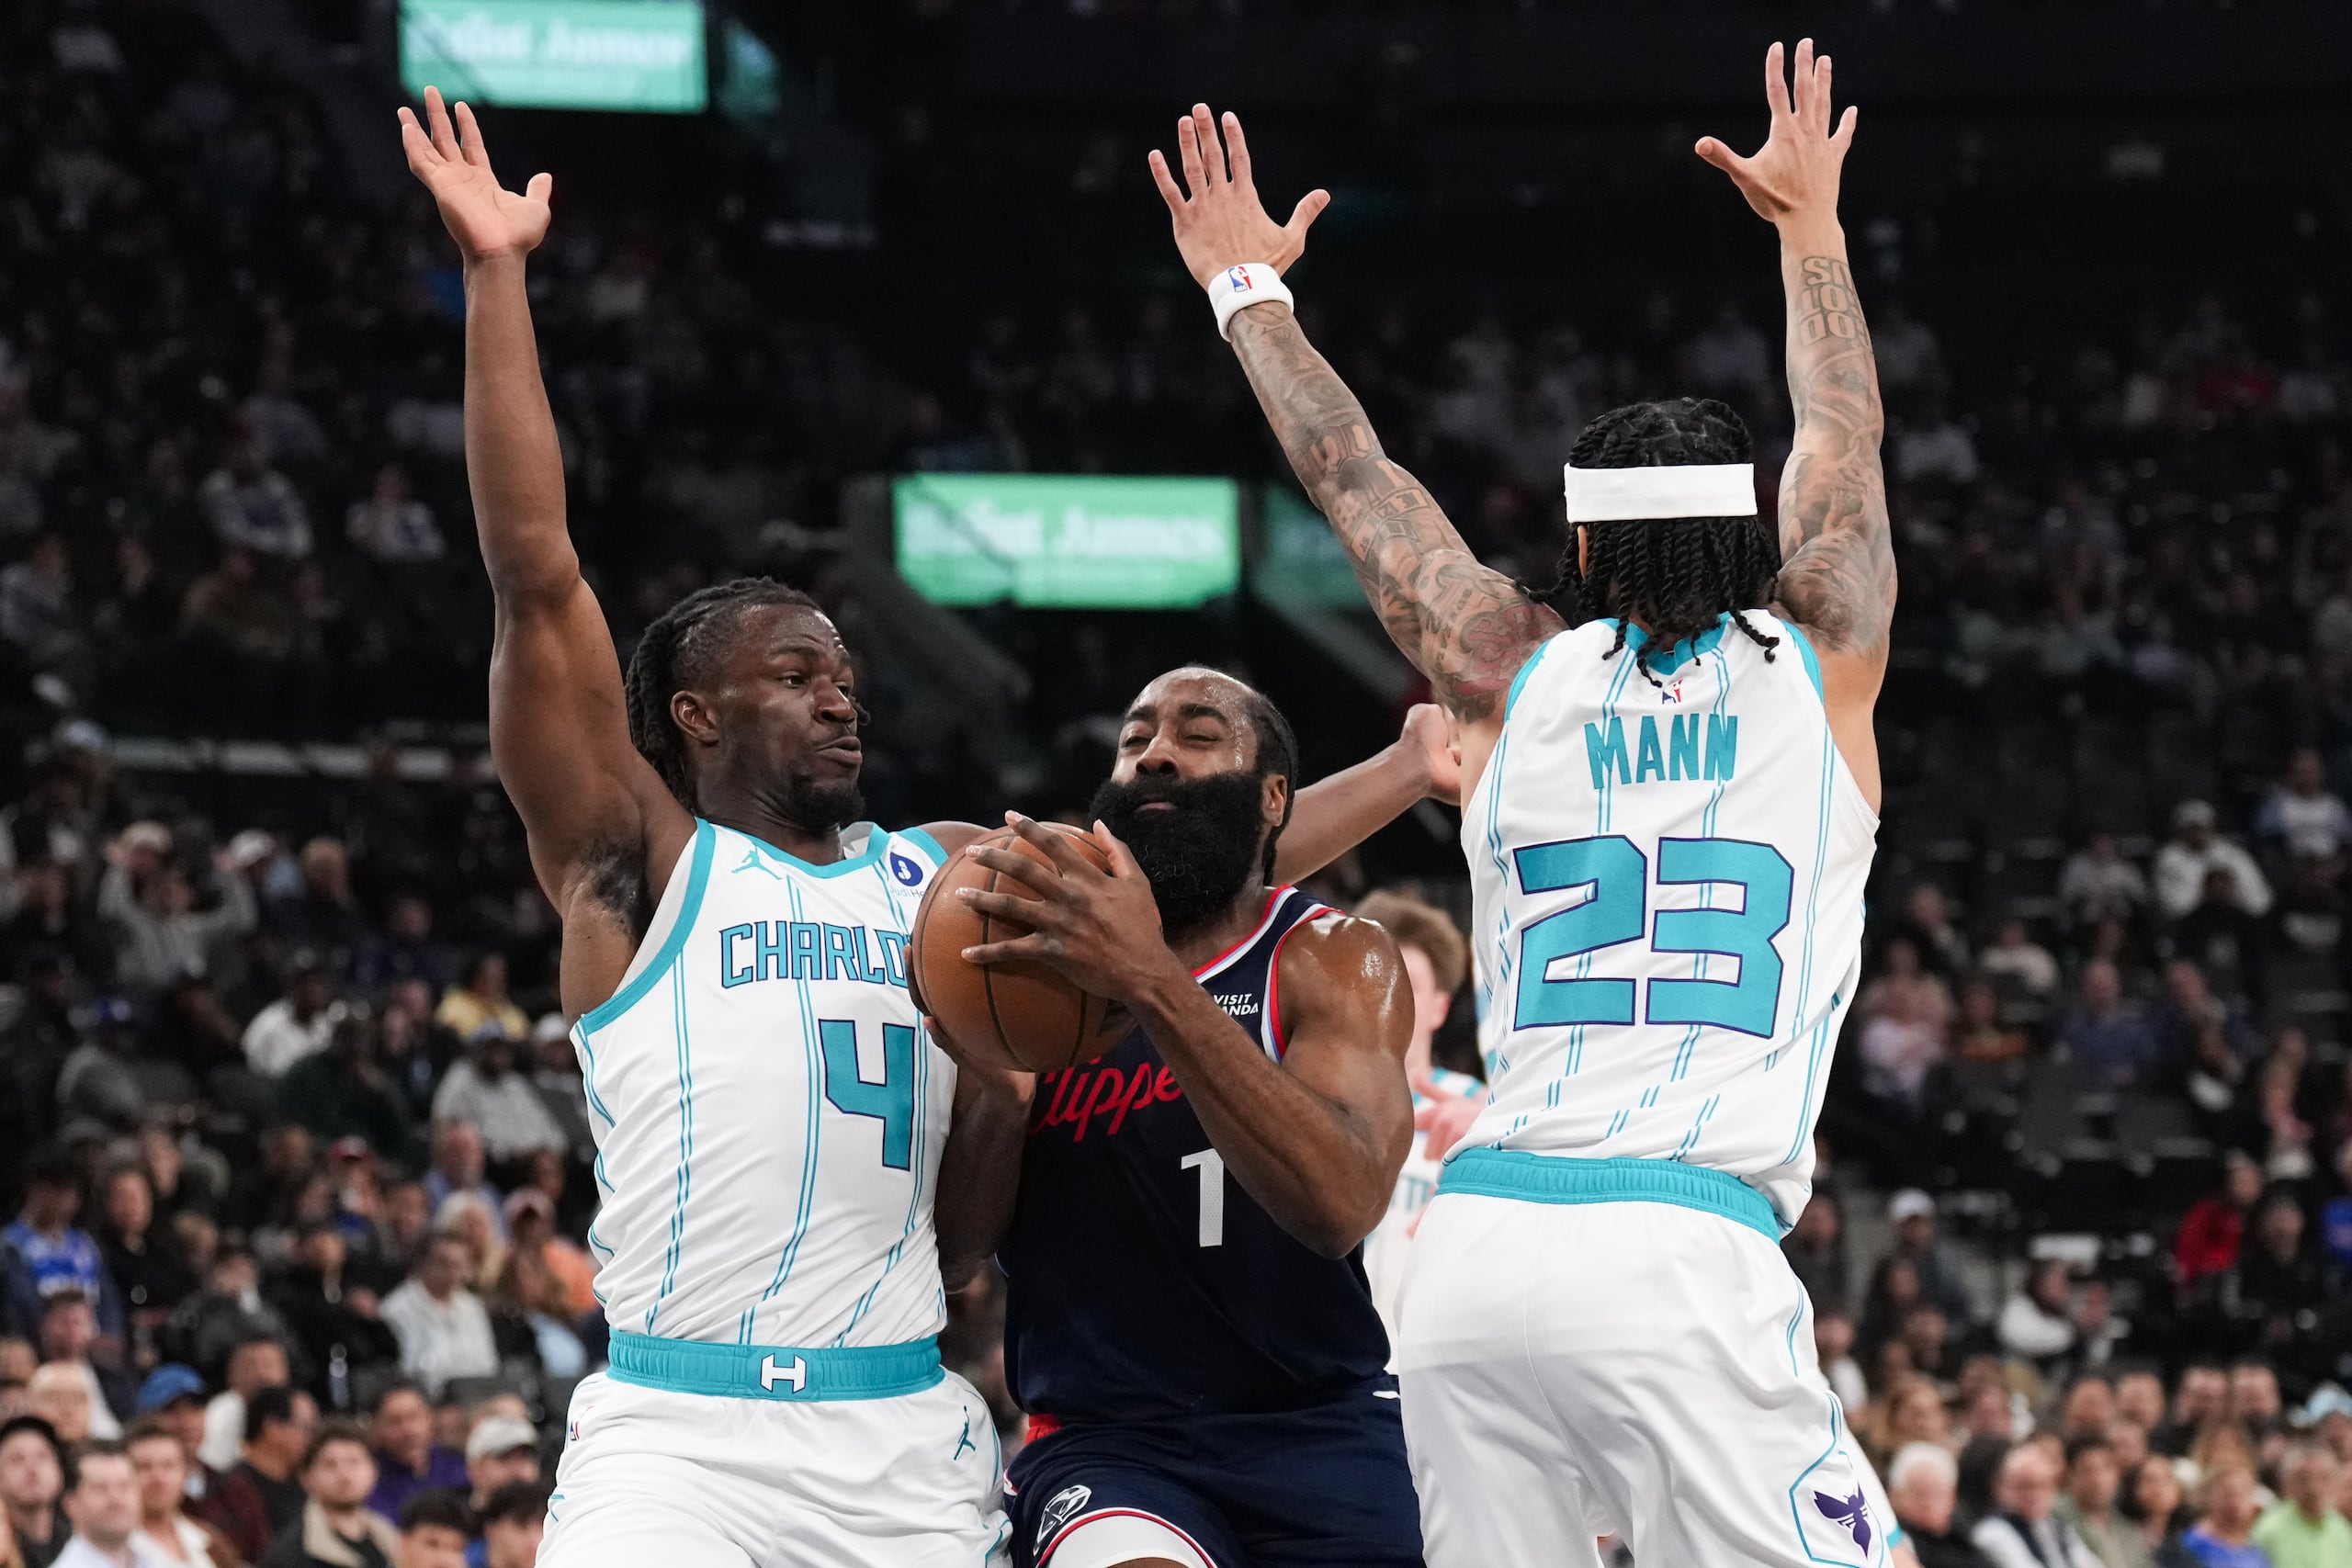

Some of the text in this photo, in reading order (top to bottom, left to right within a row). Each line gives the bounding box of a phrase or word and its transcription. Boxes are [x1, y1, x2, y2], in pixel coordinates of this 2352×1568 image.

[1584, 713, 1737, 789] MANN
[719, 920, 912, 989] CHARLO
[1512, 834, 1794, 1039] 23
[1213, 993, 1252, 1006] VISIT
[1222, 1002, 1259, 1016] ANDA
[819, 1019, 915, 1171] 4
[1028, 1056, 1183, 1143] lippe
[1181, 1148, 1224, 1247] 1
